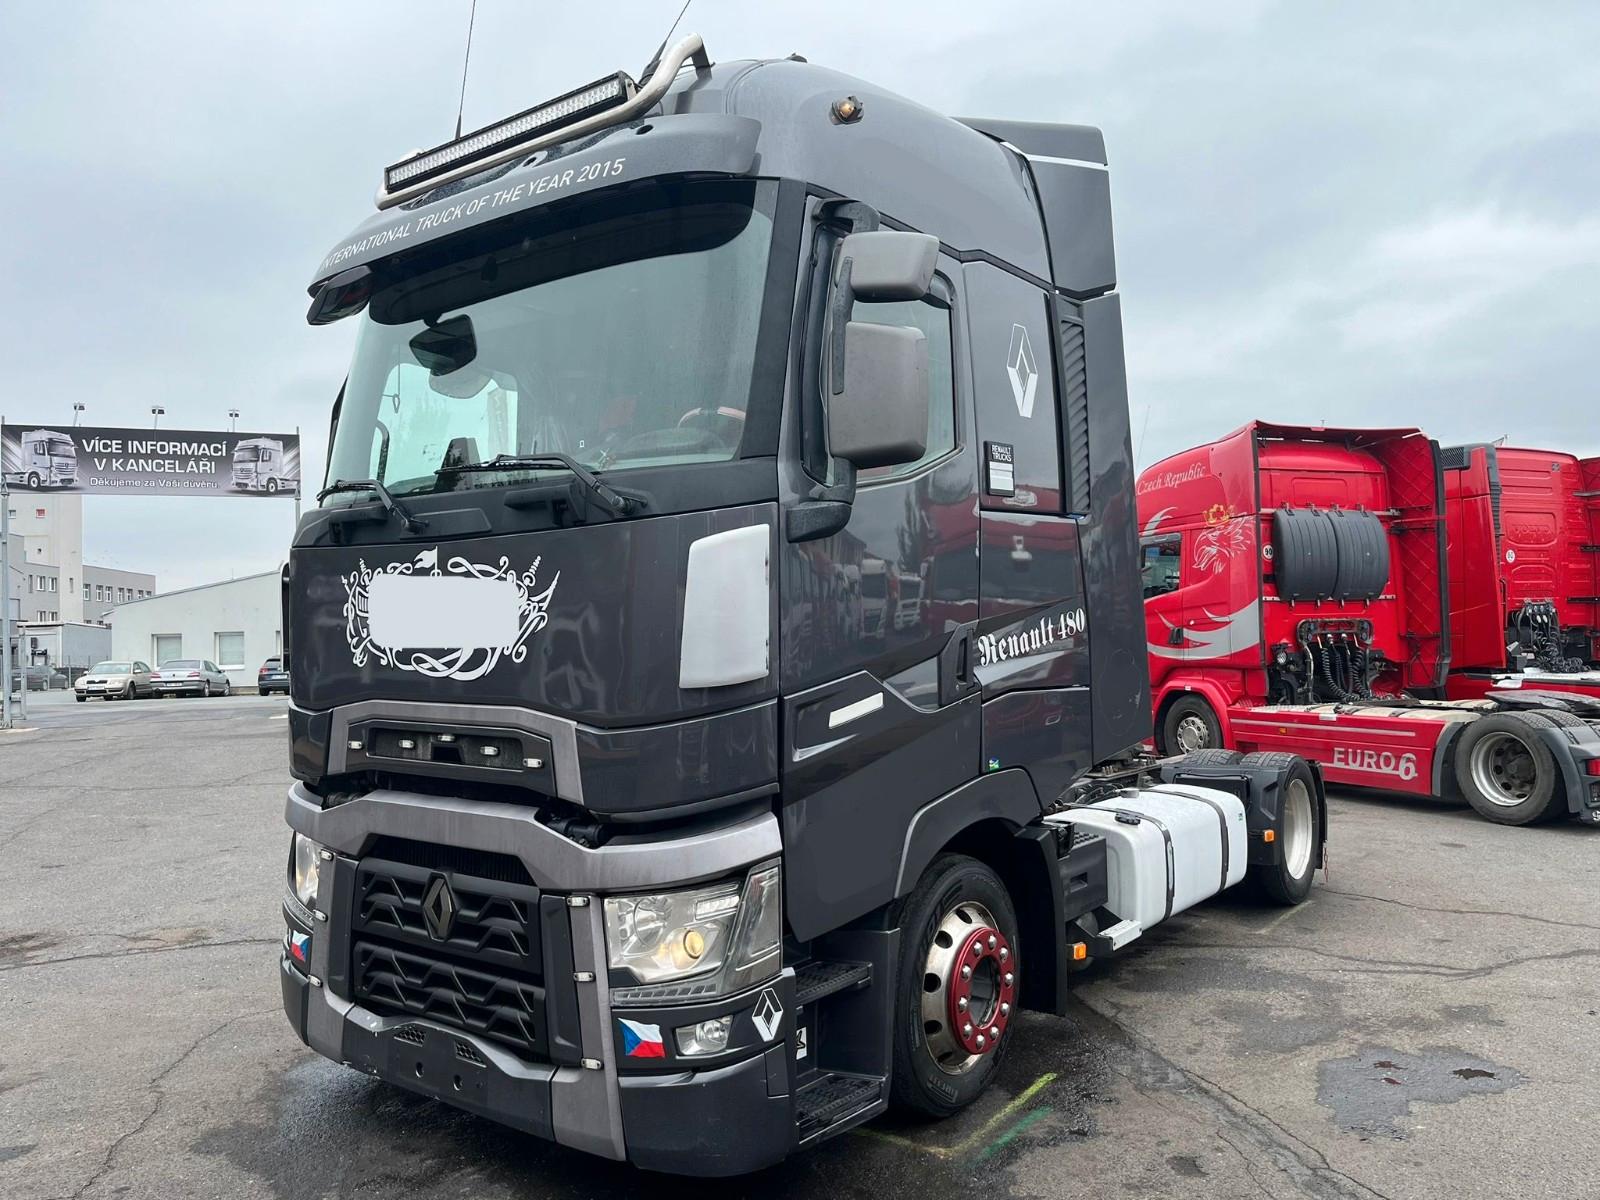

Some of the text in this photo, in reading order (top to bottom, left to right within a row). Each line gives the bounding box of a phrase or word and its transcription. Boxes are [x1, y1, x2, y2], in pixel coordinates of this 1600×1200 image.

[415, 204, 463, 233] TRUCK
[466, 195, 487, 216] OF
[490, 185, 523, 207] THE
[527, 167, 574, 196] YEAR
[576, 157, 626, 184] 2015
[82, 437, 227, 457] VÍCE INFORMACÍ
[94, 457, 216, 474] V KANCELÁŘI
[1137, 462, 1206, 496] Czech Republic
[158, 478, 180, 488] Vaši
[977, 607, 1085, 667] Renault 480
